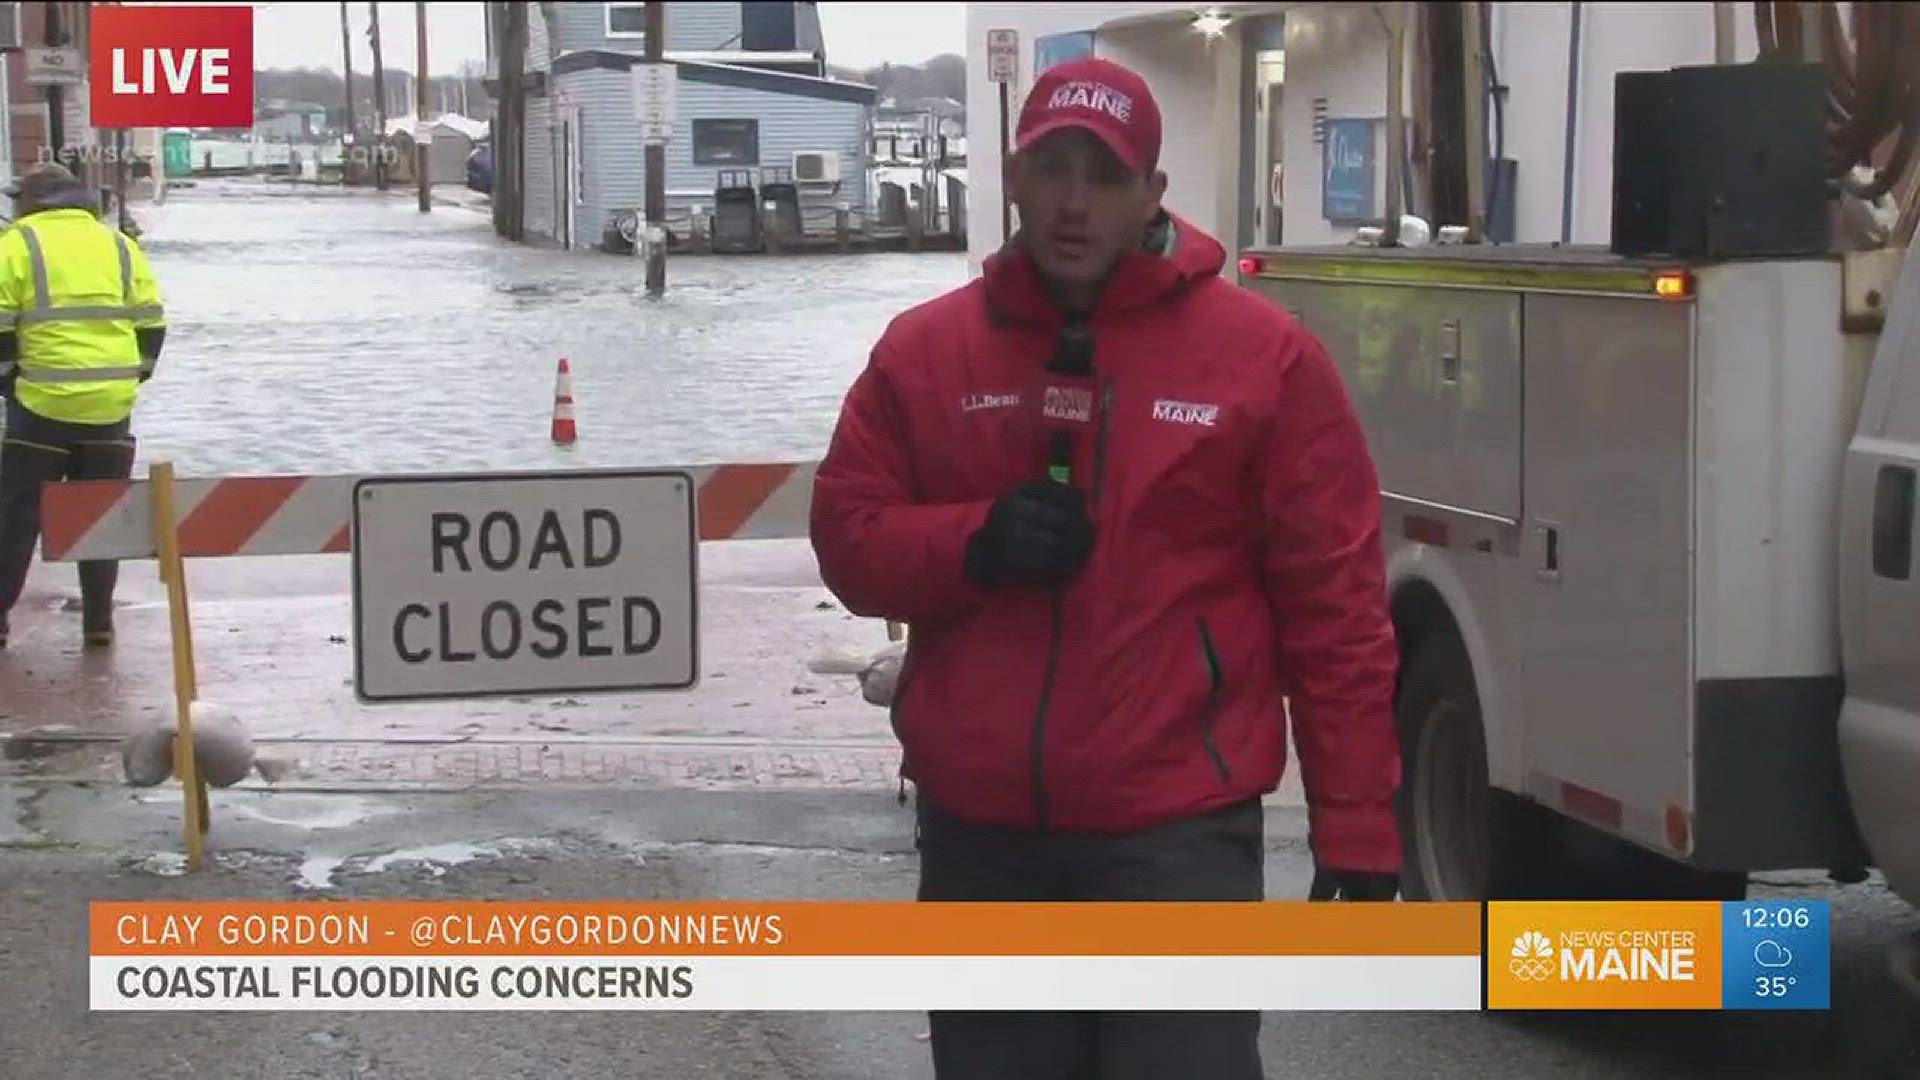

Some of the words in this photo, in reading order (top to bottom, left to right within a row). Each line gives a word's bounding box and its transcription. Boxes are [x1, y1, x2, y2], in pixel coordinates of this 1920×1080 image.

[1048, 87, 1132, 123] MAINE
[1153, 405, 1218, 426] MAINE
[431, 509, 623, 574] ROAD
[393, 596, 662, 664] CLOSED
